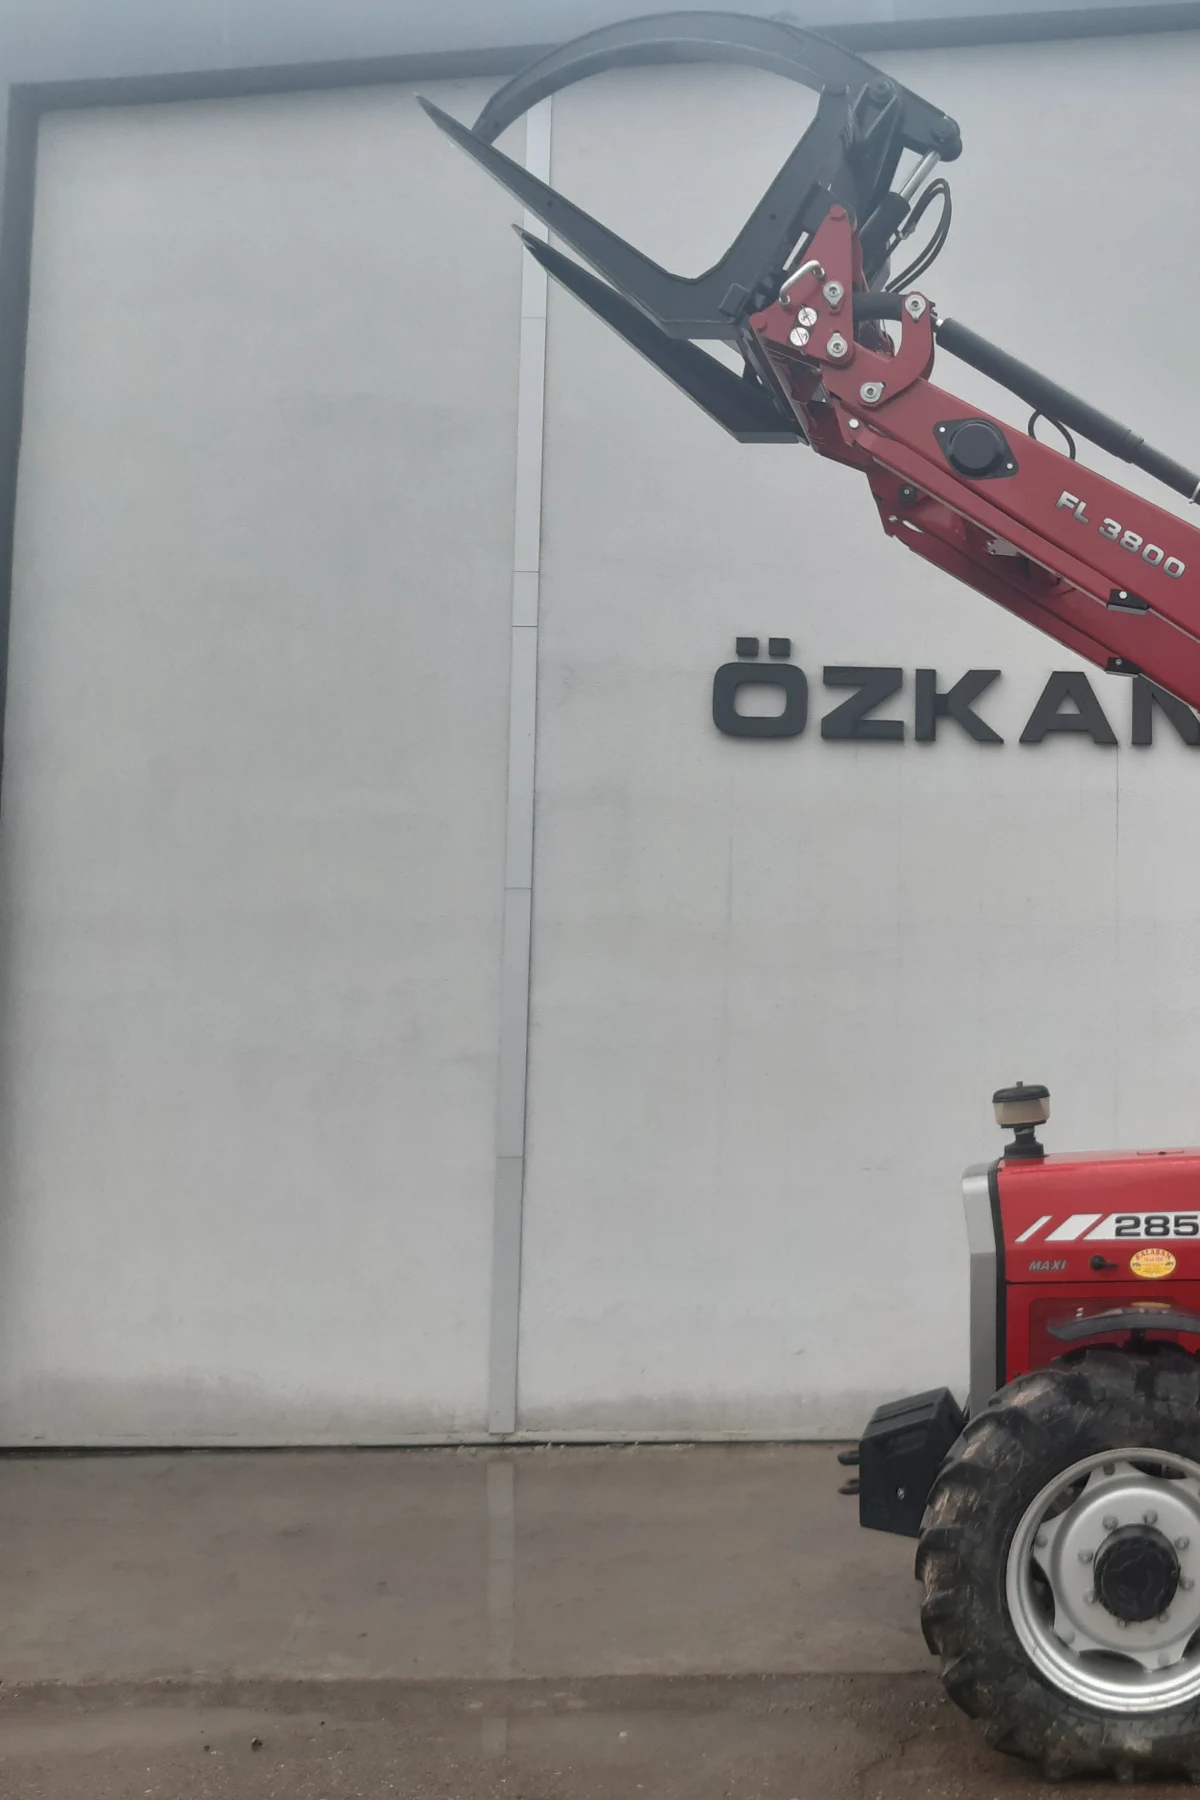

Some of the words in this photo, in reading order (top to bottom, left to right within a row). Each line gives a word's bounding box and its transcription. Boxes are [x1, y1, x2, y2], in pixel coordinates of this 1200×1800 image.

[1055, 490, 1089, 525] FL
[1098, 517, 1186, 579] 3800
[1029, 1259, 1067, 1271] MAXI
